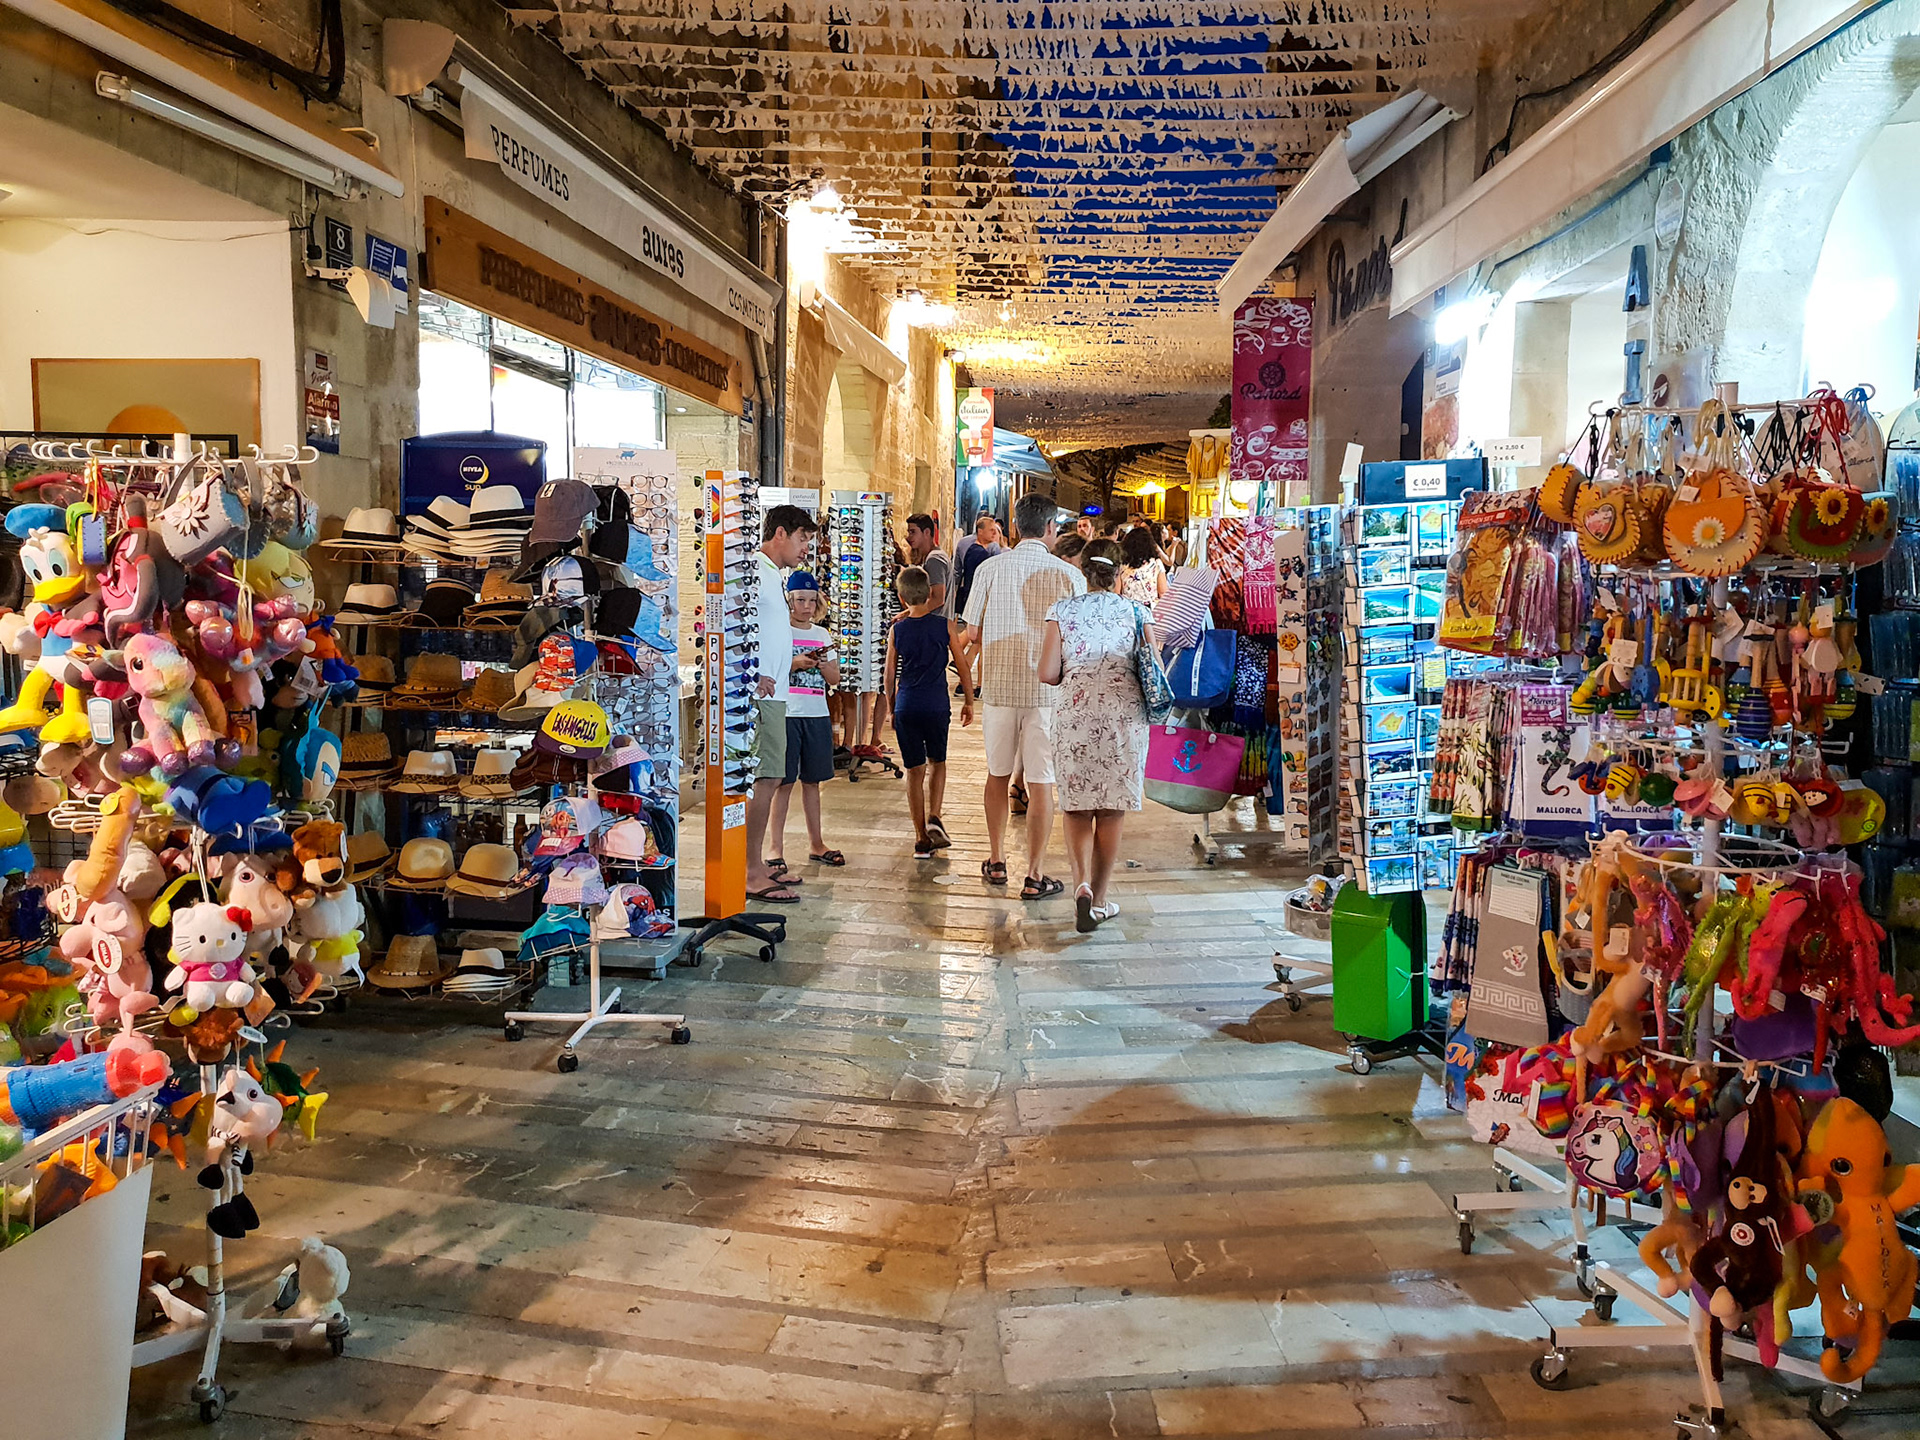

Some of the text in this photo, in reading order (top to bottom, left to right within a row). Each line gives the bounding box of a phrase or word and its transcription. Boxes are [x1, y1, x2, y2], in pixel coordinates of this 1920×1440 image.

[489, 123, 570, 202] PERFUMES
[336, 228, 346, 250] 8
[642, 225, 684, 279] aures
[1421, 478, 1441, 487] 0,40
[710, 637, 719, 763] POLARIZED
[1536, 806, 1583, 815] MALLORCA
[1612, 805, 1660, 814] MLORCA
